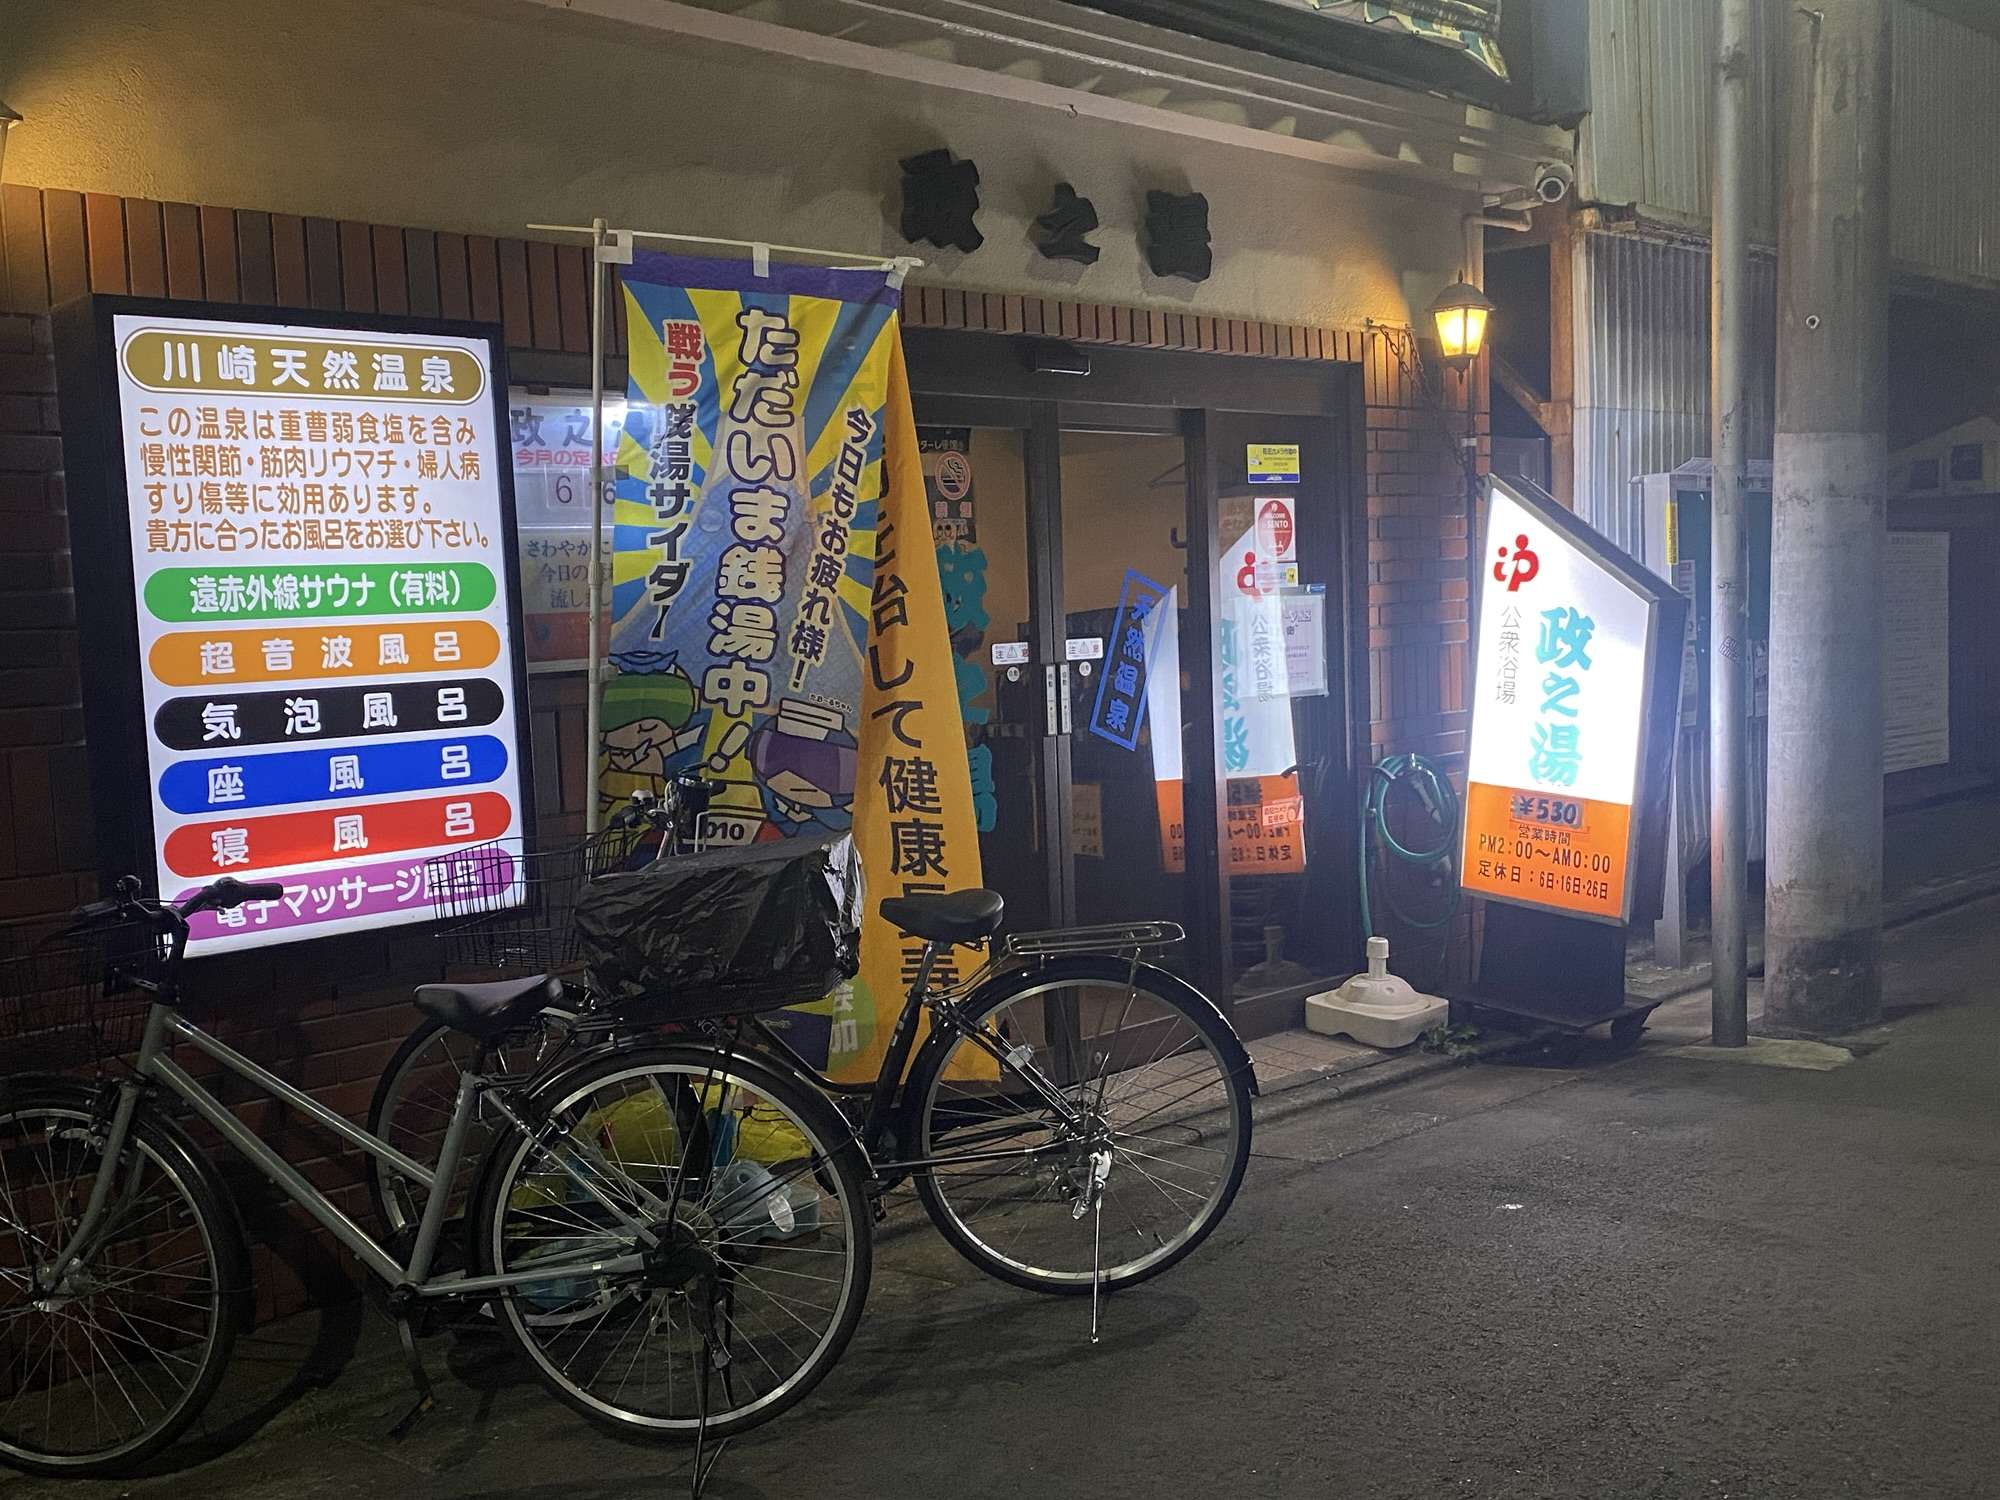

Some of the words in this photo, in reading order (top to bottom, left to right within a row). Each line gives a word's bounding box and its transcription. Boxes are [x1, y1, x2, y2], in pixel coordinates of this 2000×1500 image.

[162, 342, 455, 394] 川崎天然温泉
[139, 406, 476, 446] この温泉は重曹弱食塩を含み
[511, 406, 621, 447] 政之
[140, 444, 481, 481] 慢性関節・筋肉リウマチ・婦人病
[516, 449, 617, 466] 今月の定
[143, 483, 432, 515] すり傷等に効用あります。
[556, 475, 573, 504] 6
[146, 517, 489, 553] 貴方に合ったお風呂をお選び下さい。
[703, 307, 800, 773] ただいま銭湯中！
[790, 408, 873, 689] 今日もお疲れ様！
[189, 570, 461, 613] 遠赤外線サウナ（有料）
[200, 631, 461, 676] 超音波風呂
[201, 687, 468, 742] 気泡風呂
[1530, 606, 1596, 787] 政之湯
[207, 745, 472, 804] 座風呂
[1519, 796, 1577, 824] ¥530
[211, 802, 476, 868] 寝風呂
[1518, 825, 1572, 847] 営業時間
